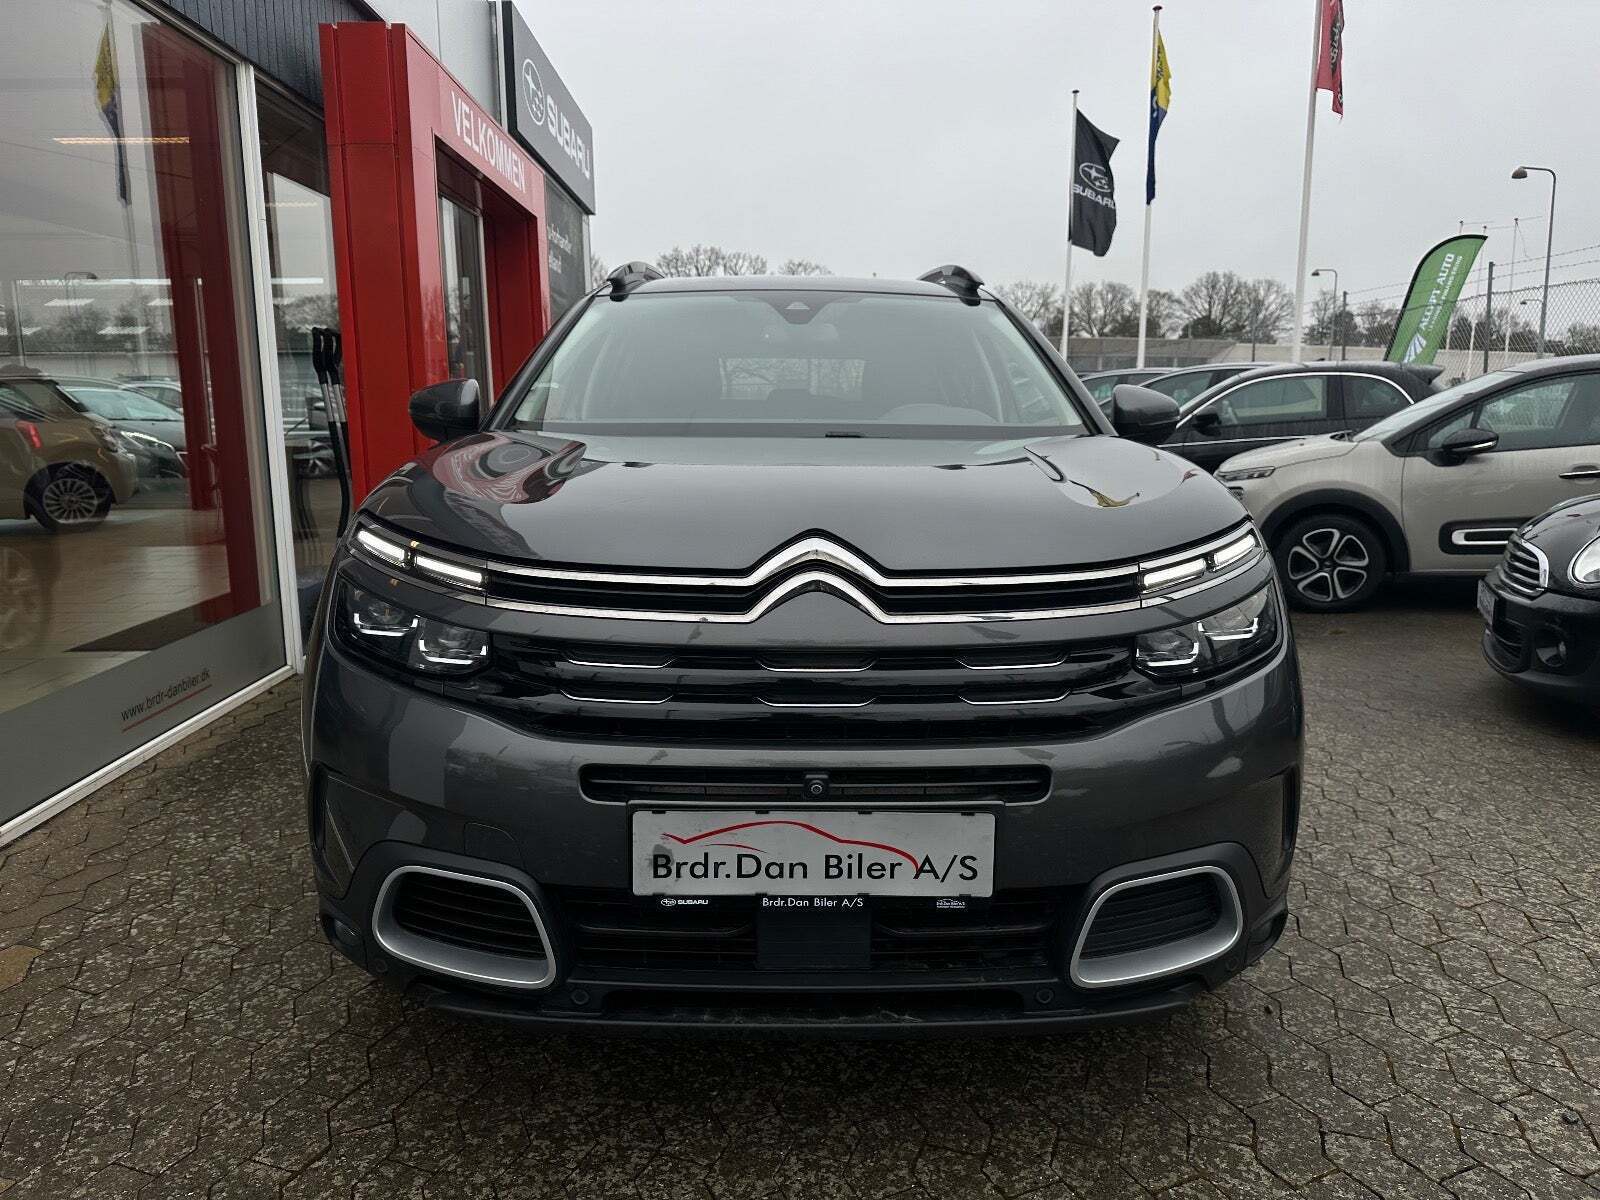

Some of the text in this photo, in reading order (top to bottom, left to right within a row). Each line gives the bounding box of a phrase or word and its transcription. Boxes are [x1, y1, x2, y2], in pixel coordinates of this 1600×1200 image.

[451, 90, 526, 193] VELKOMMEN
[546, 94, 590, 180] SUBARU
[1436, 253, 1456, 286] AUTO
[120, 668, 212, 722] www.brdr-danbiler.dk
[652, 851, 979, 884] Brdr.Dan Biler A/S
[762, 897, 864, 908] Brdr.Dan Biler A/S
